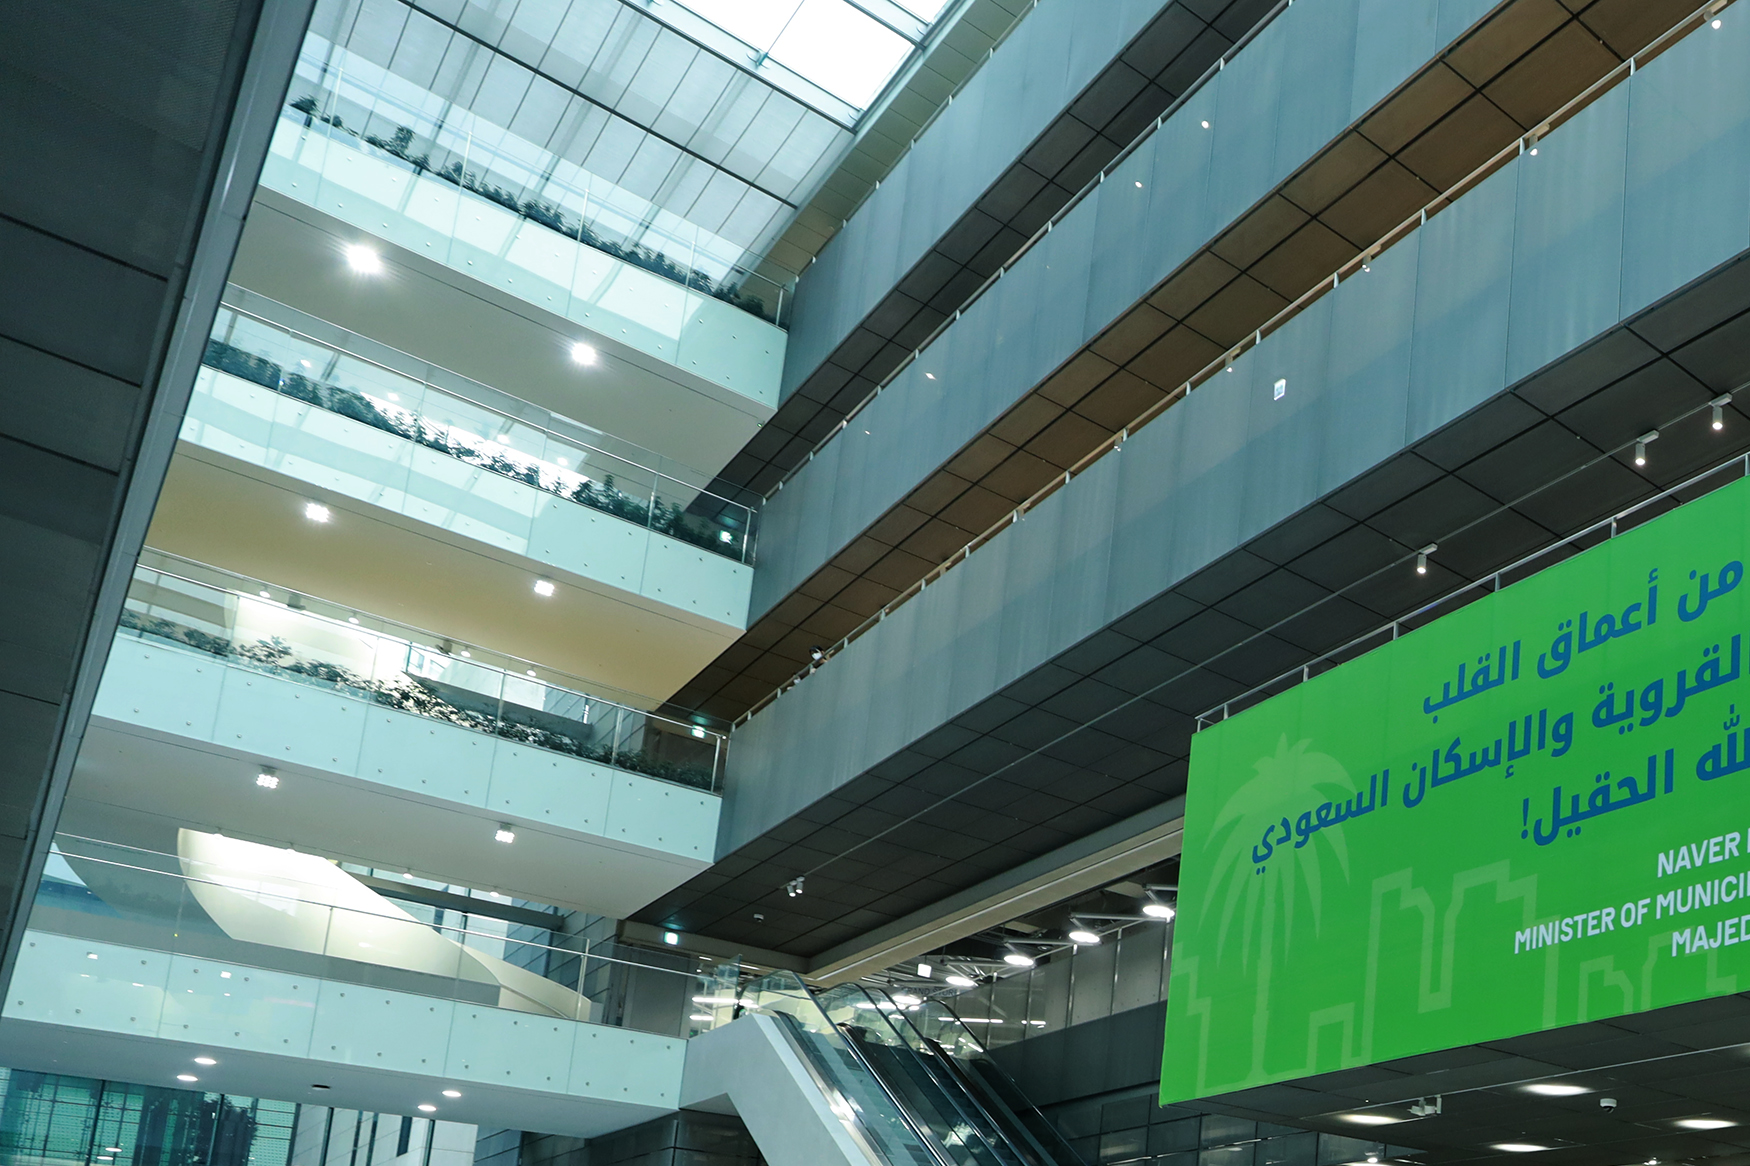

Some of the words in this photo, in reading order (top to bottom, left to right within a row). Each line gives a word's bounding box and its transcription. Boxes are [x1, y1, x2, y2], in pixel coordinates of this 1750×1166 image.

[1537, 567, 1659, 680] أعماق
[1677, 560, 1744, 623] من
[1422, 640, 1522, 724] القلب
[1403, 707, 1575, 809] والإسكان
[1521, 748, 1675, 846] الحقيل!
[1251, 768, 1391, 876] السعودي
[1657, 831, 1741, 878] NAVER
[1514, 906, 1616, 955] MINISTER
[1620, 897, 1651, 928] OF
